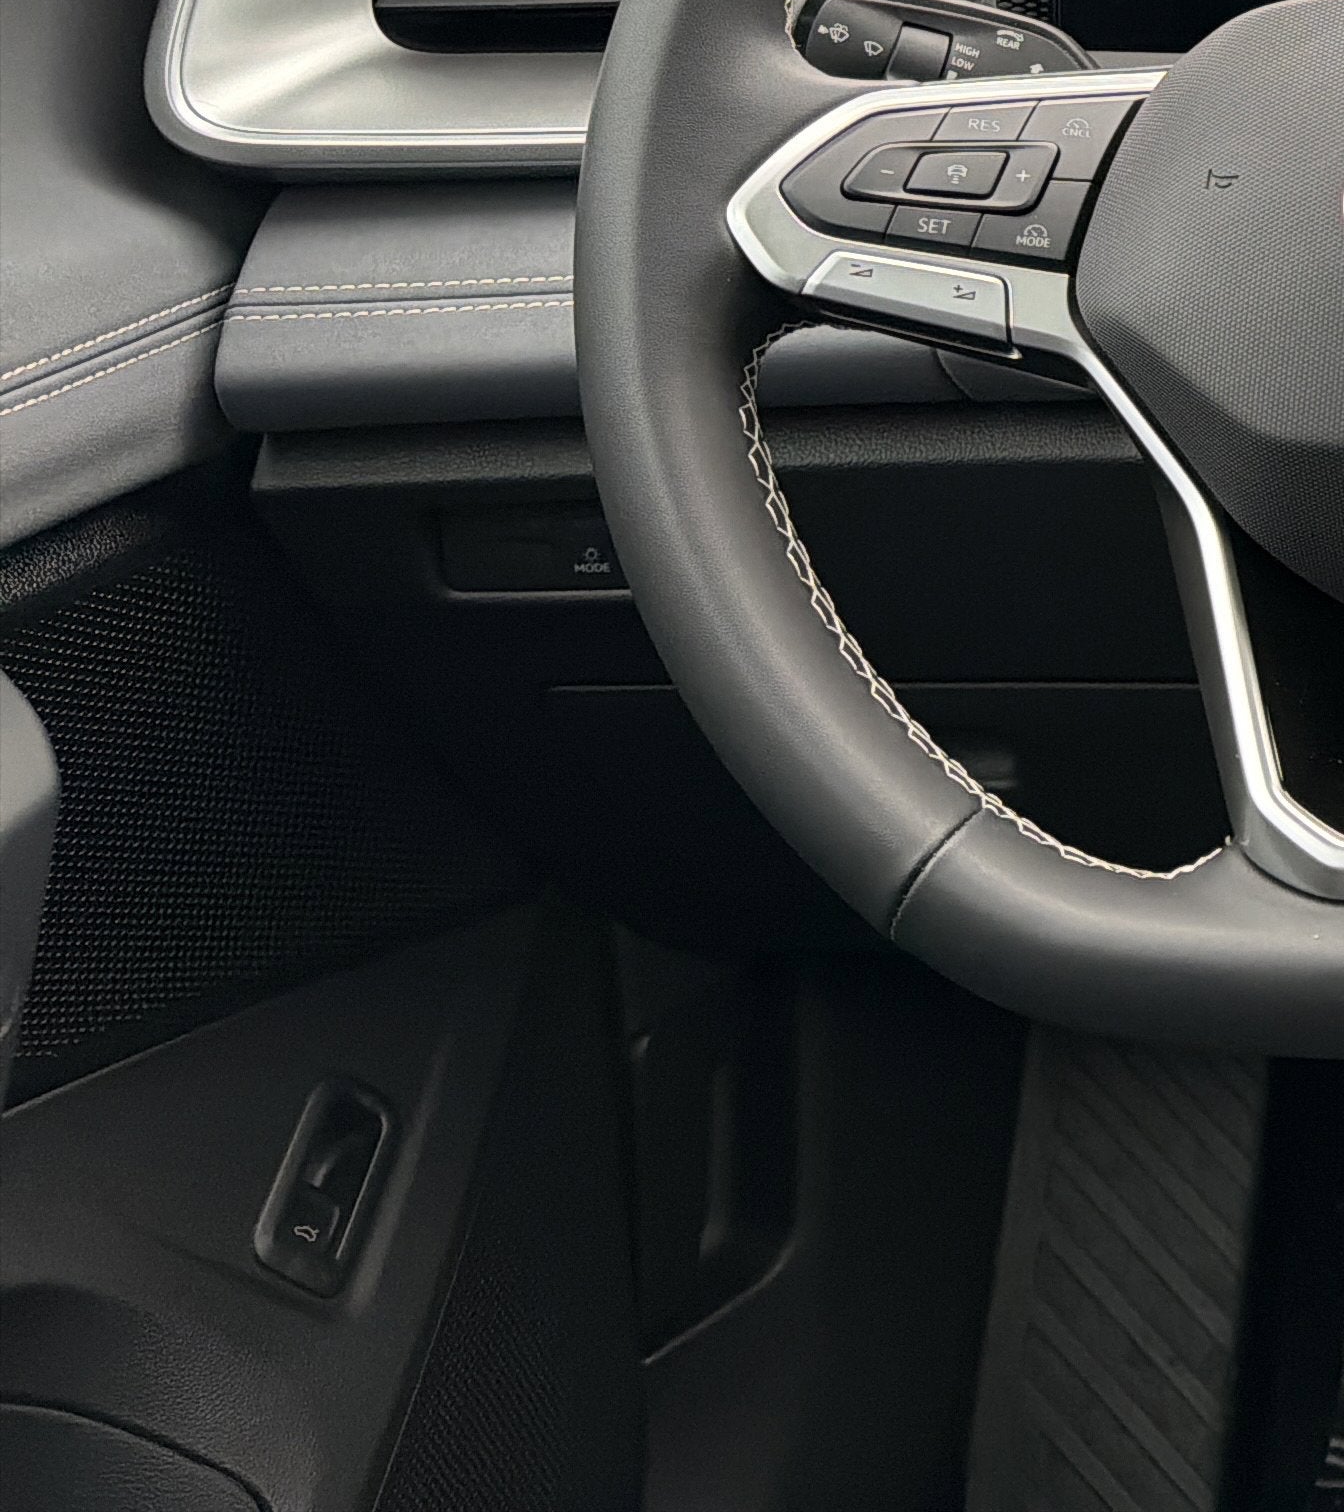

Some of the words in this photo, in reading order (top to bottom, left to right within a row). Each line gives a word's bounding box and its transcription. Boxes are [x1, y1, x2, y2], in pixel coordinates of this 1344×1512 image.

[954, 41, 981, 60] HIGH
[995, 36, 1021, 51] REAR
[950, 55, 976, 71] LOW
[967, 117, 1002, 133] RES
[1061, 126, 1092, 139] CNCL
[916, 217, 950, 236] SET
[1016, 234, 1051, 249] MODE
[574, 562, 611, 573] MODE
